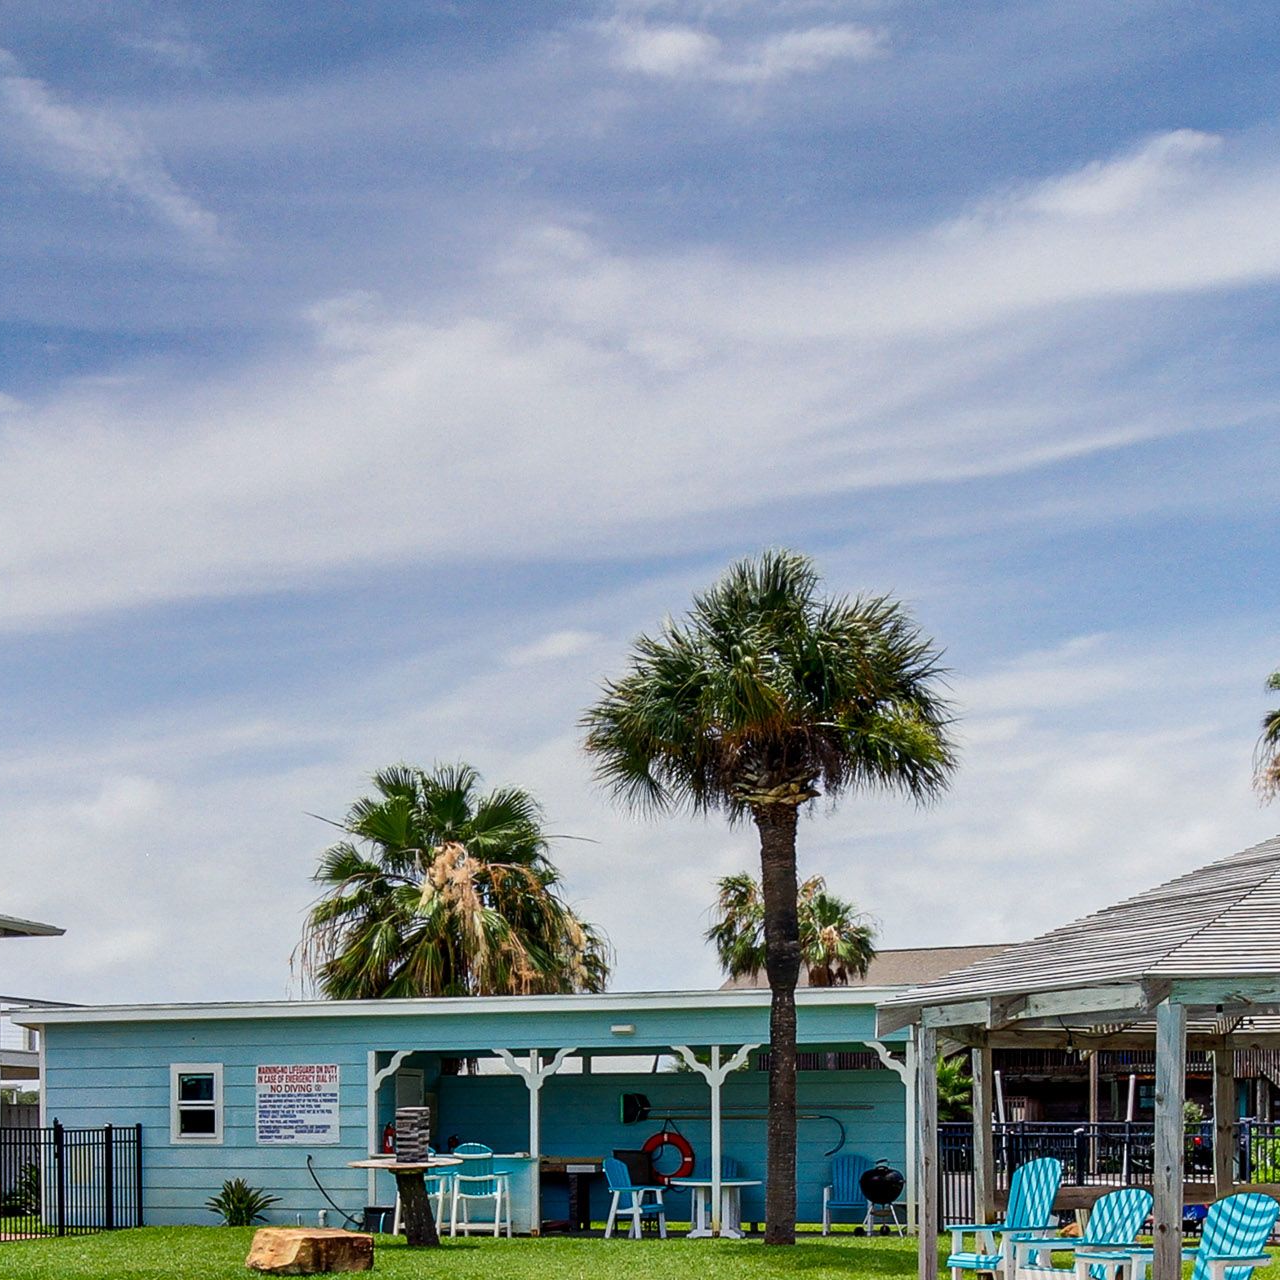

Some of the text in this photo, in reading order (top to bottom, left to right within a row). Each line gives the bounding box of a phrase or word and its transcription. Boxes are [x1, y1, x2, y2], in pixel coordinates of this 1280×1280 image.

[289, 1066, 315, 1074] LIFEGUARD
[316, 1066, 323, 1074] ON
[324, 1065, 337, 1074] DUTY
[258, 1074, 337, 1083] IN CASE OF EMERGENCY DIAL 911
[270, 1084, 312, 1093] NO DIVING
